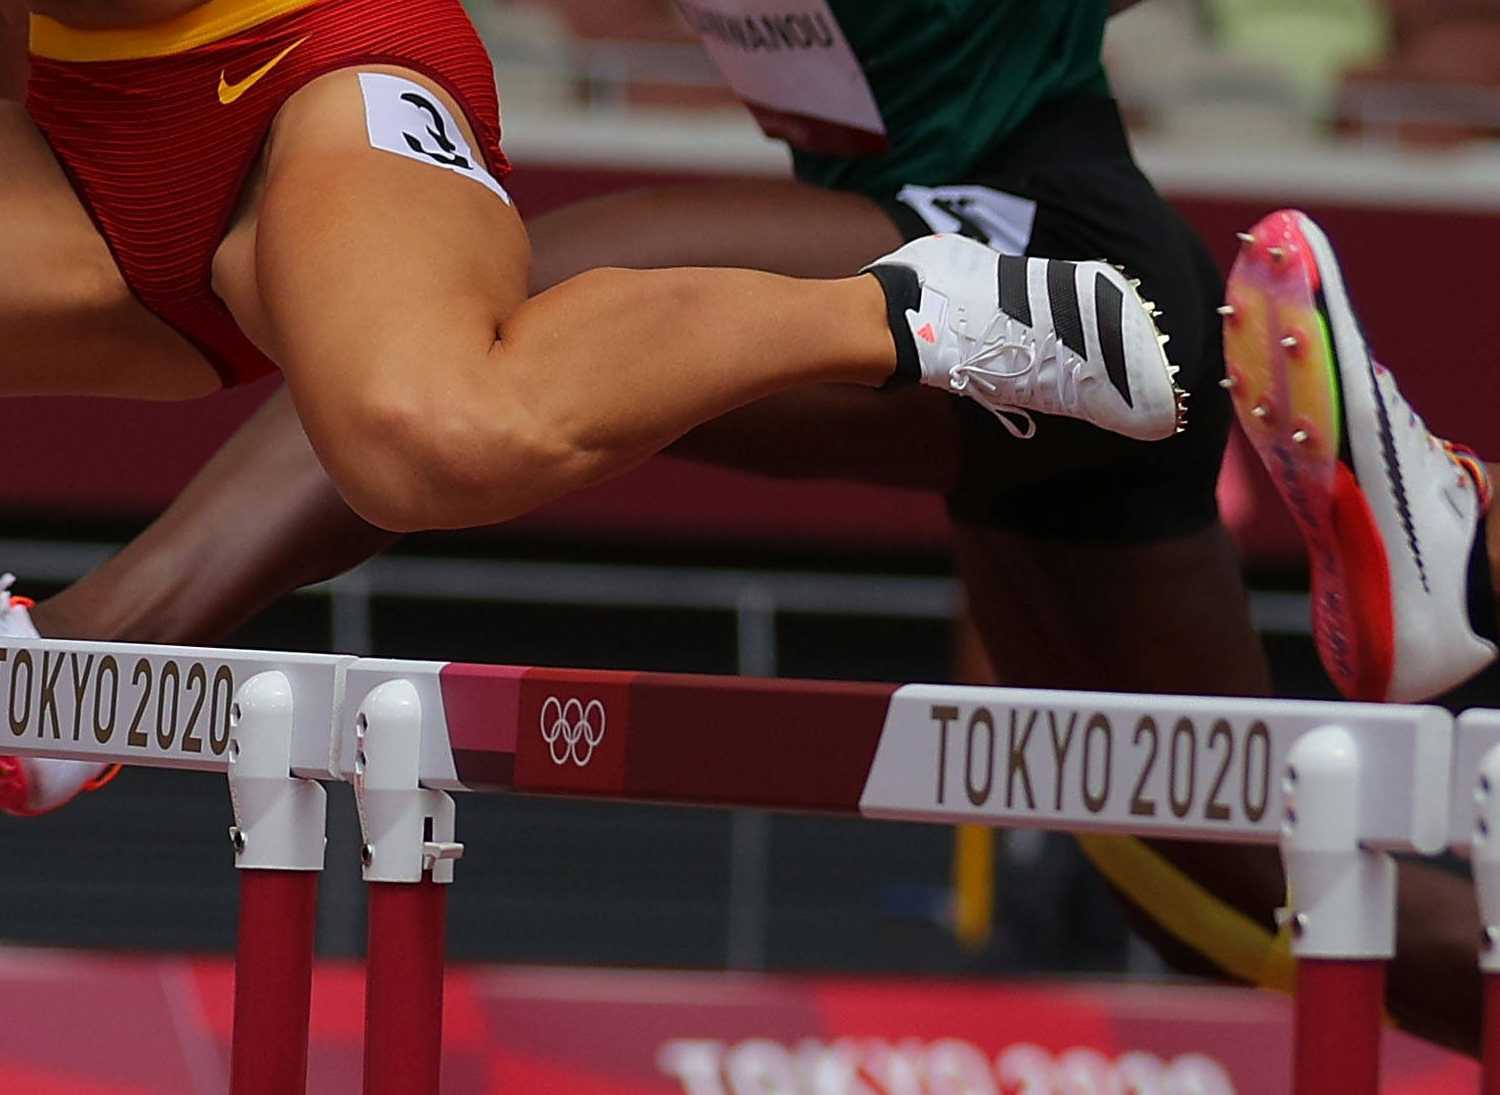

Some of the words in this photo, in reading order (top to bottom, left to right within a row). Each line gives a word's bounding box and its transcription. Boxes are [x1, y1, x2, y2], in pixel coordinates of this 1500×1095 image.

[127, 657, 234, 756] 2020
[930, 705, 1112, 813] TOKYO
[1129, 714, 1271, 823] 2020
